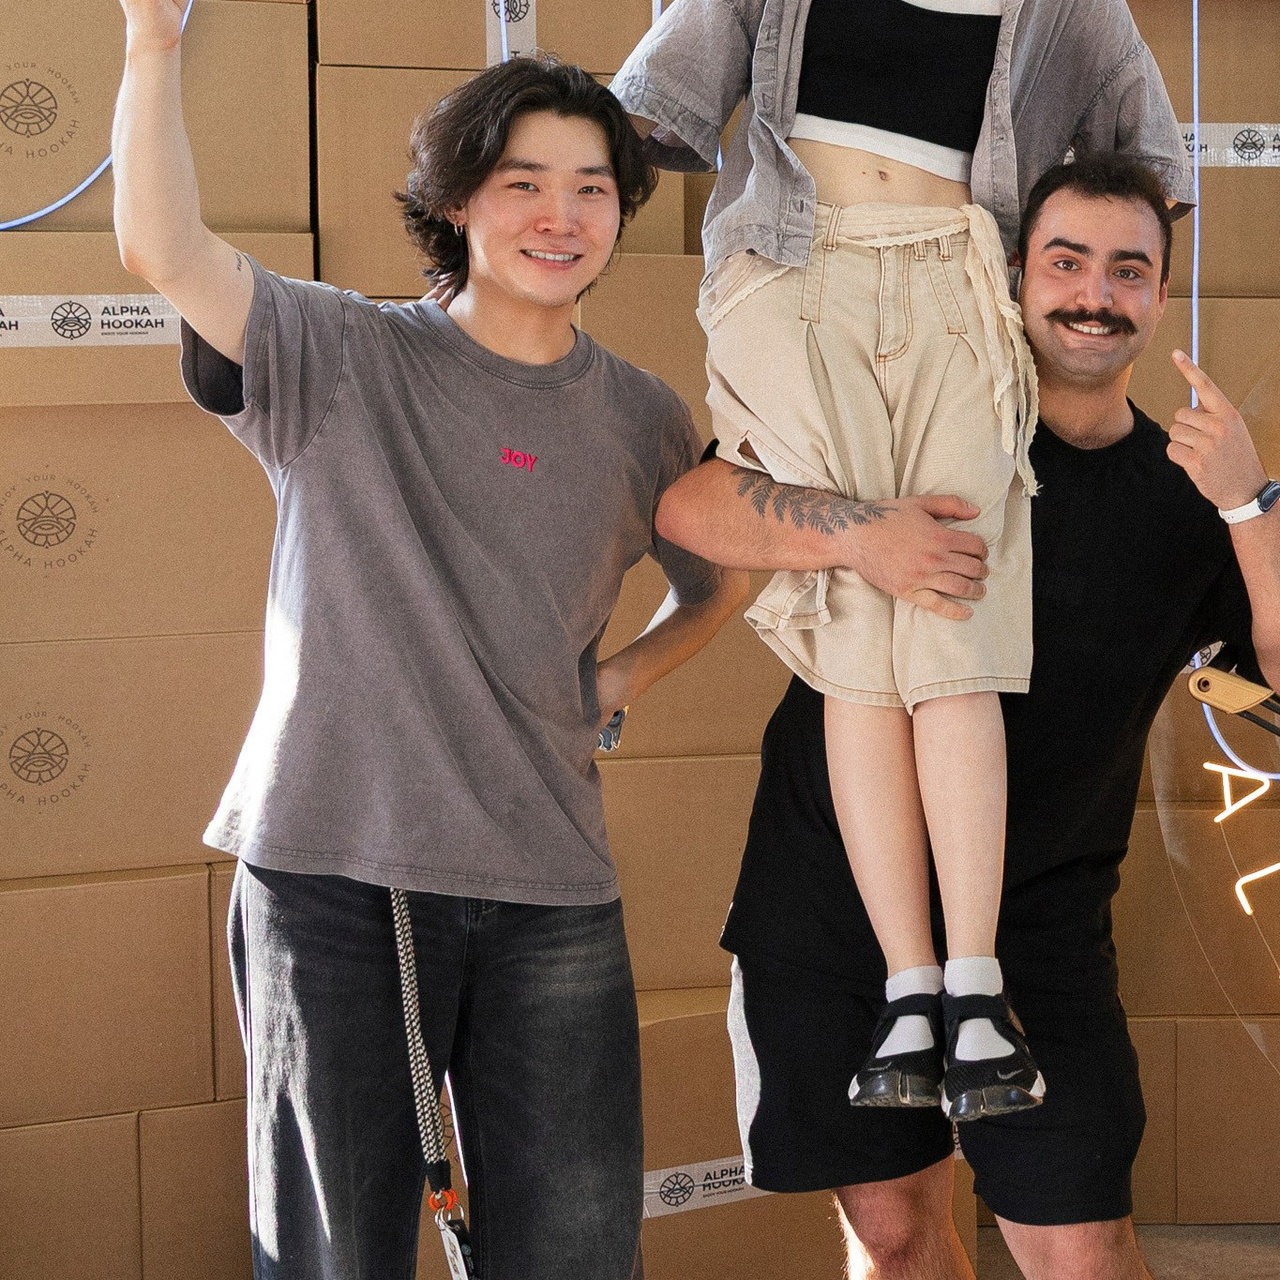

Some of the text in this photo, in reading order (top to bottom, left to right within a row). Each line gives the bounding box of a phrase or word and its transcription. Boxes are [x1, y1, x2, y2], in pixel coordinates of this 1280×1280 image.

[26, 119, 80, 159] HOOKAH
[101, 306, 151, 316] ALPHA
[101, 319, 165, 330] HOOKAH
[499, 447, 538, 472] JOY
[44, 528, 98, 569] HOOKAH
[38, 763, 91, 806] HOOKAH
